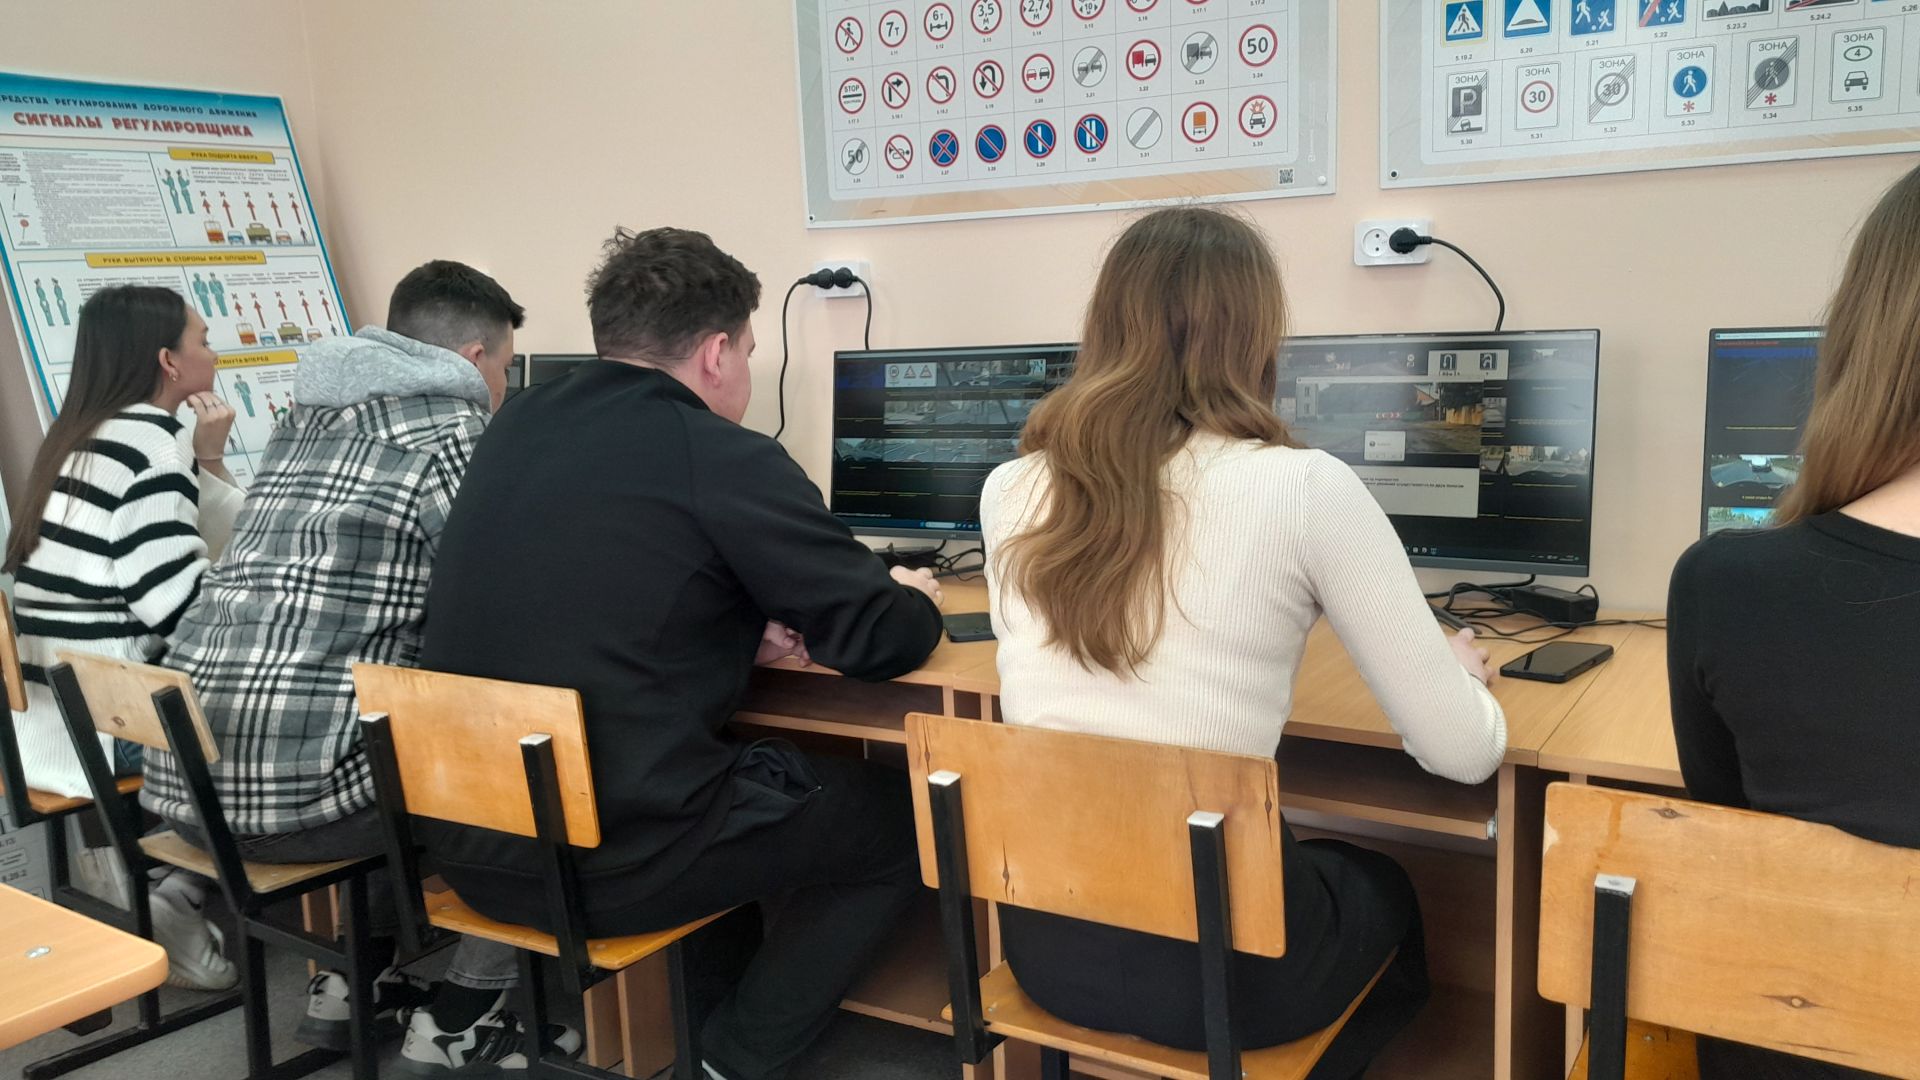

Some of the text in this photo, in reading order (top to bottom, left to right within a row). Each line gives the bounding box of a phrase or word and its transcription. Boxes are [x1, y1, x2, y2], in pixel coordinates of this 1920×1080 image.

[978, 3, 994, 17] 3,5
[1028, 0, 1044, 12] 2,7
[932, 10, 939, 20] 6
[1810, 13, 1832, 21] 5.24.2
[886, 22, 894, 37] 7
[1726, 22, 1747, 30] 5.23.2
[1843, 33, 1874, 43] ЗОНА
[1247, 36, 1268, 55] 50
[1758, 41, 1788, 52] ЗОНА
[1677, 50, 1705, 61] ЗОНА
[1854, 48, 1861, 57] 4
[1599, 59, 1626, 69] ЗОНА
[1525, 67, 1551, 77] ЗОНА
[1455, 74, 1479, 84] ЗОНА
[844, 84, 860, 93] STOP
[1602, 82, 1621, 96] 30
[1461, 89, 1477, 115] P
[1529, 90, 1546, 104] 30
[55, 98, 138, 110] РЕГУЛИРОВАНИЯ
[143, 103, 204, 115] ДОРОЖНОГО
[208, 108, 258, 118] ДВИЖЕНИЯ
[13, 111, 254, 138] СИГНАЛЫ РЕГУЛИРОВЩИКА
[848, 149, 864, 164] 50
